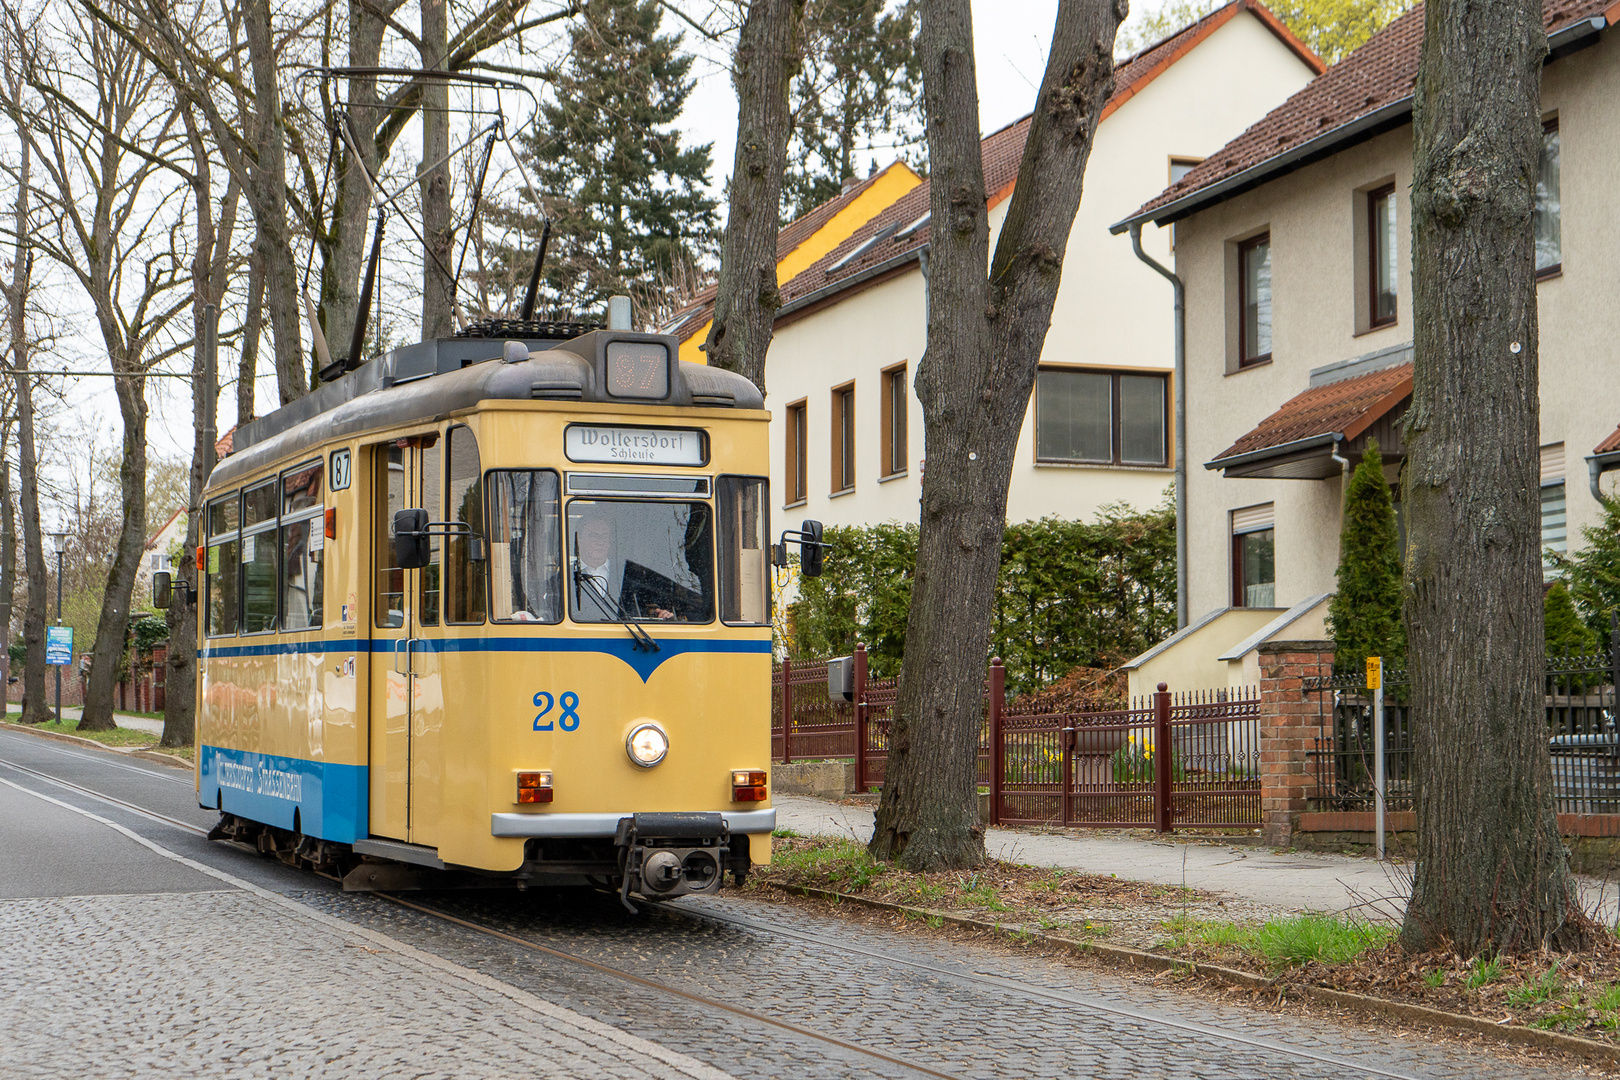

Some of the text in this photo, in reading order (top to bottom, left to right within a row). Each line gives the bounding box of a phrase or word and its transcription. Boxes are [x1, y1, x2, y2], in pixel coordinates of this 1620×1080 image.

[616, 354, 660, 389] 87
[580, 428, 684, 451] Woltersdorf
[335, 453, 350, 486] 87
[532, 691, 580, 732] 28
